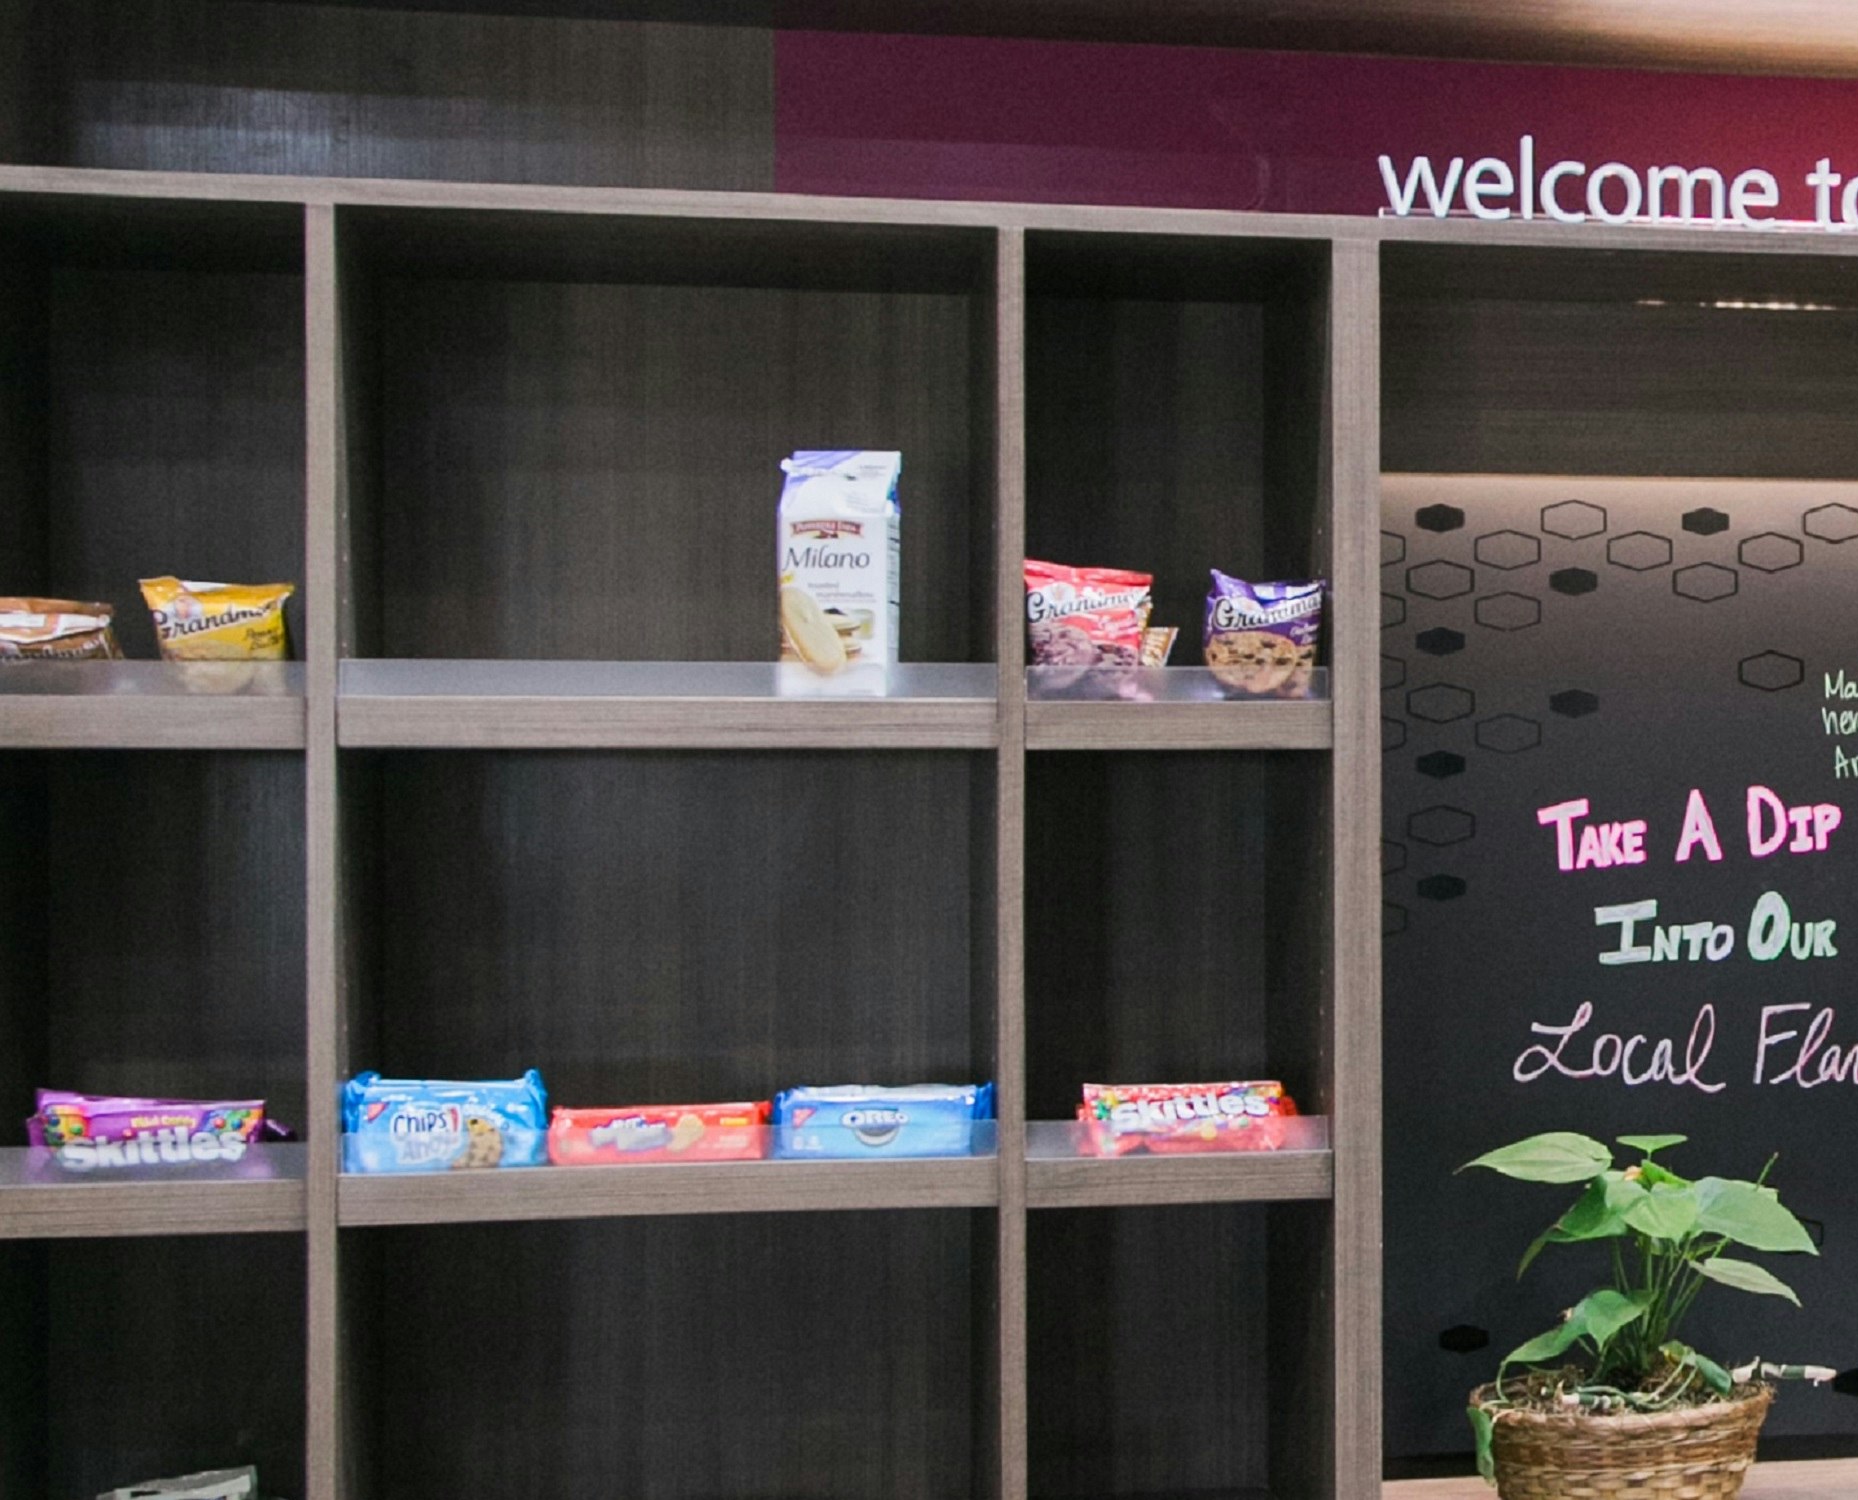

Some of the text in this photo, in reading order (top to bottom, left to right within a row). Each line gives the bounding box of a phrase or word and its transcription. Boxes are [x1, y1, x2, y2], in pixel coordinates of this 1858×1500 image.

[1379, 135, 1779, 224] welcome
[782, 545, 870, 571] Milano
[1675, 788, 1723, 862] A
[1512, 1000, 1727, 1093] Local
[843, 1110, 909, 1127] OREO
